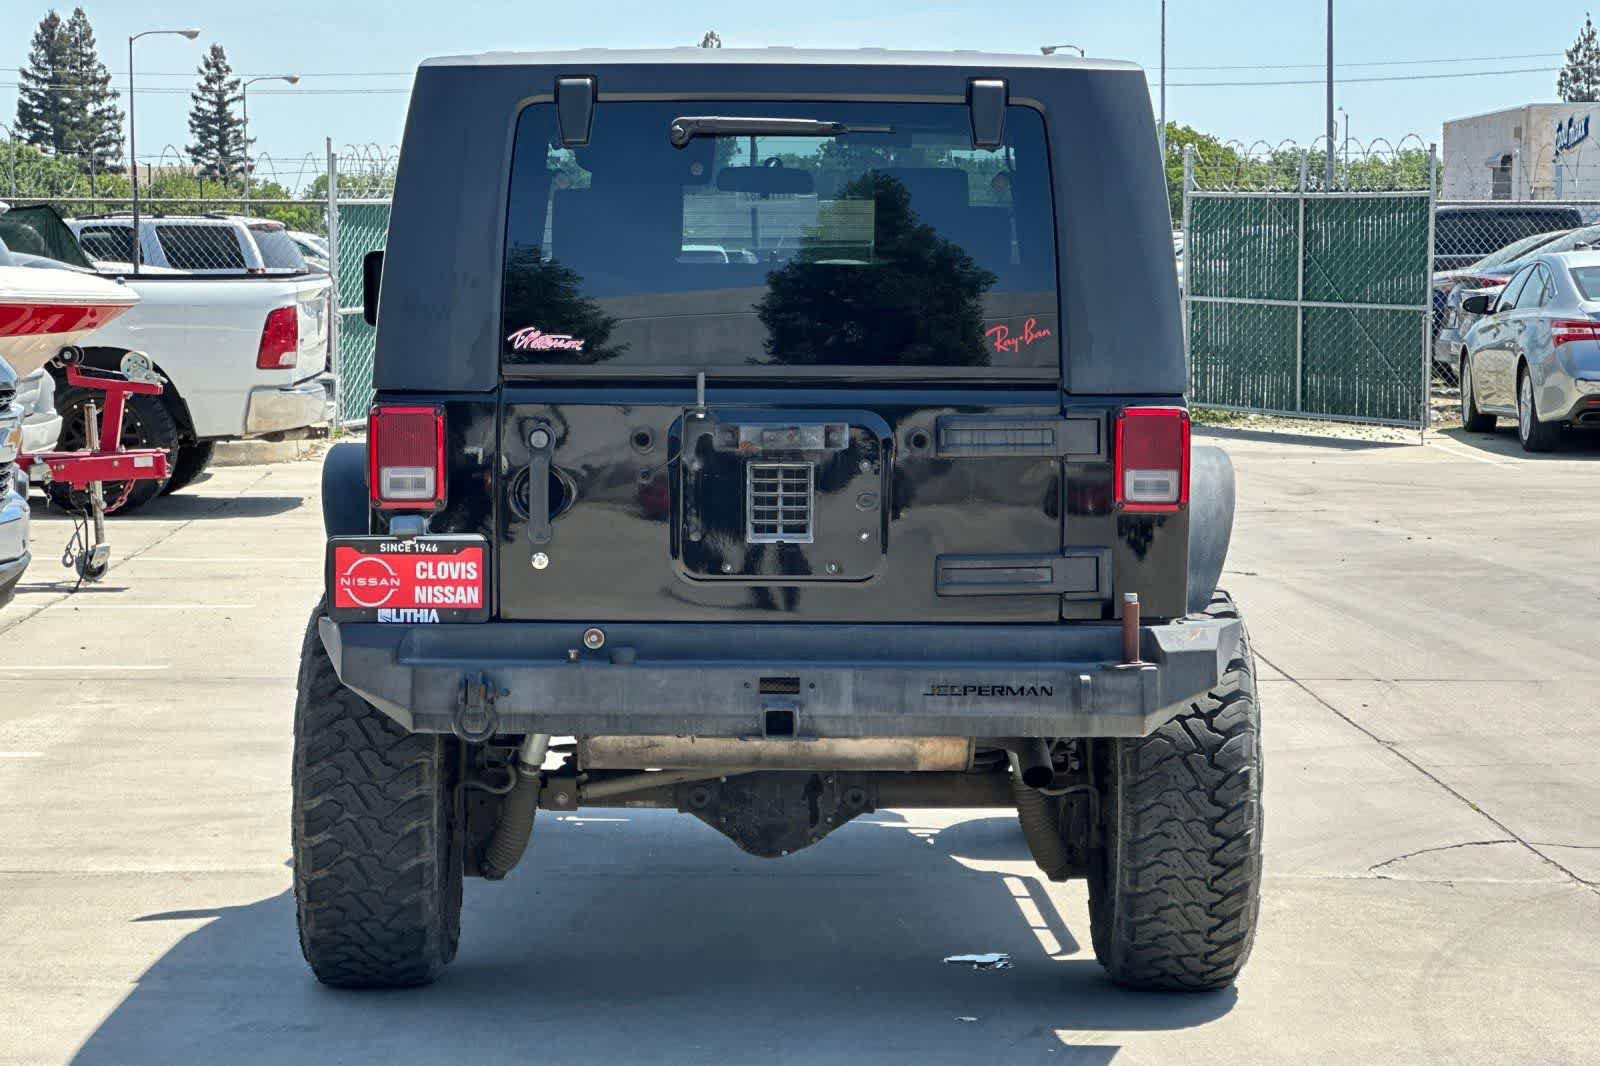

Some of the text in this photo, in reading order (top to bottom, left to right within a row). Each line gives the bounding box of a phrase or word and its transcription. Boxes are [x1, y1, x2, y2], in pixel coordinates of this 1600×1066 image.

[380, 543, 438, 553] SINCE 1946
[415, 560, 478, 581] CLOVIS
[340, 577, 401, 587] NISSAN
[414, 585, 479, 604] NISSAN
[391, 608, 440, 623] LITHIA
